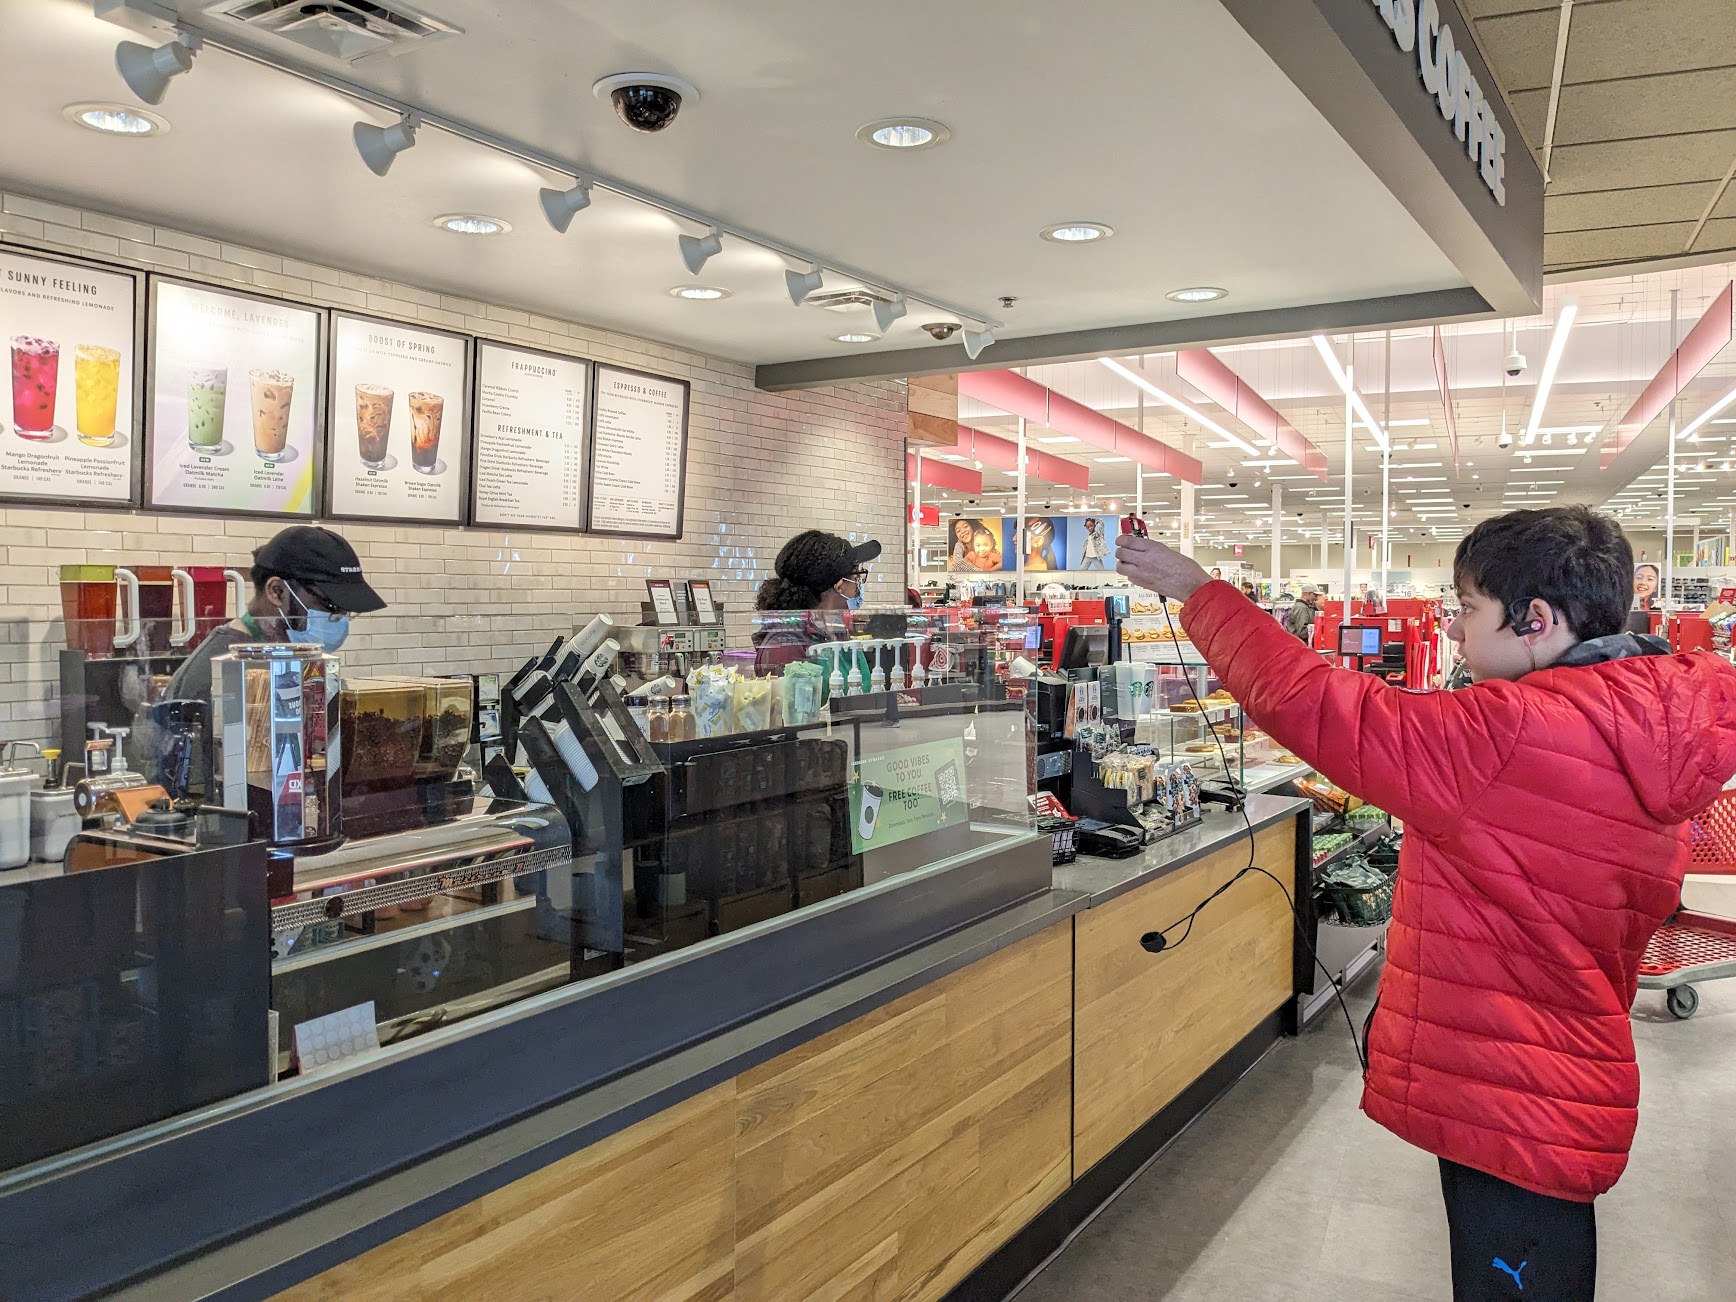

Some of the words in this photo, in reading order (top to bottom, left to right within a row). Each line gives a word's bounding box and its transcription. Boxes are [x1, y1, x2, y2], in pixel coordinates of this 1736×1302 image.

[8, 270, 47, 286] SUNNY
[53, 278, 97, 296] FEELING
[0, 286, 25, 296] LAVORS
[42, 294, 80, 306] REFRESHING
[82, 301, 114, 311] LEMONADE
[369, 334, 393, 346] BOOST
[397, 340, 405, 348] OF
[408, 342, 435, 354] SPRING
[512, 362, 556, 377] FRAPPUCCINO
[614, 382, 640, 393] ESPRESSO
[649, 388, 667, 398] COFFEE
[498, 424, 542, 437] REFRESHMENT
[887, 759, 909, 772] GOOD
[910, 754, 930, 767] VIBES
[896, 772, 905, 783] TO
[888, 790, 906, 802] FREE
[907, 782, 932, 796] COFFEE
